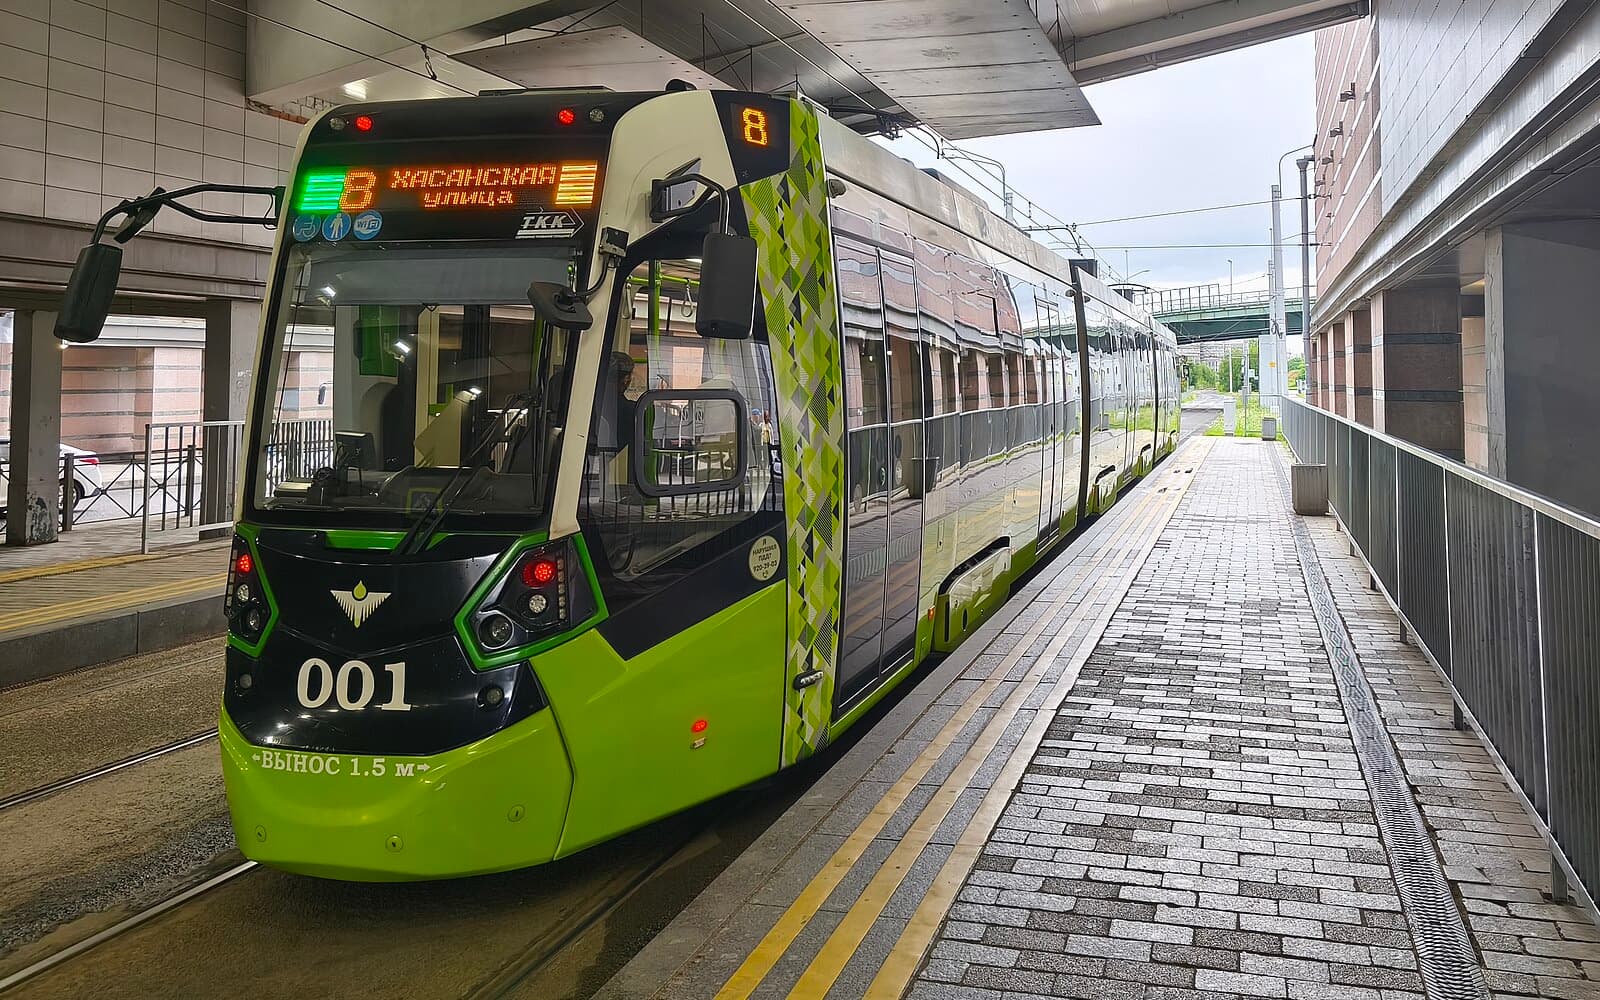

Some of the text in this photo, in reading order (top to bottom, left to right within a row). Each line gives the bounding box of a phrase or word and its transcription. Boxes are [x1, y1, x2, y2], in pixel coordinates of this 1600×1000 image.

[743, 108, 767, 145] 8
[340, 170, 377, 210] 8
[391, 165, 557, 189] ХАСАНСКАЯ
[423, 190, 514, 208] улица
[297, 657, 412, 711] 001
[262, 750, 340, 775] ВЫНОС
[350, 758, 386, 777] 1.5
